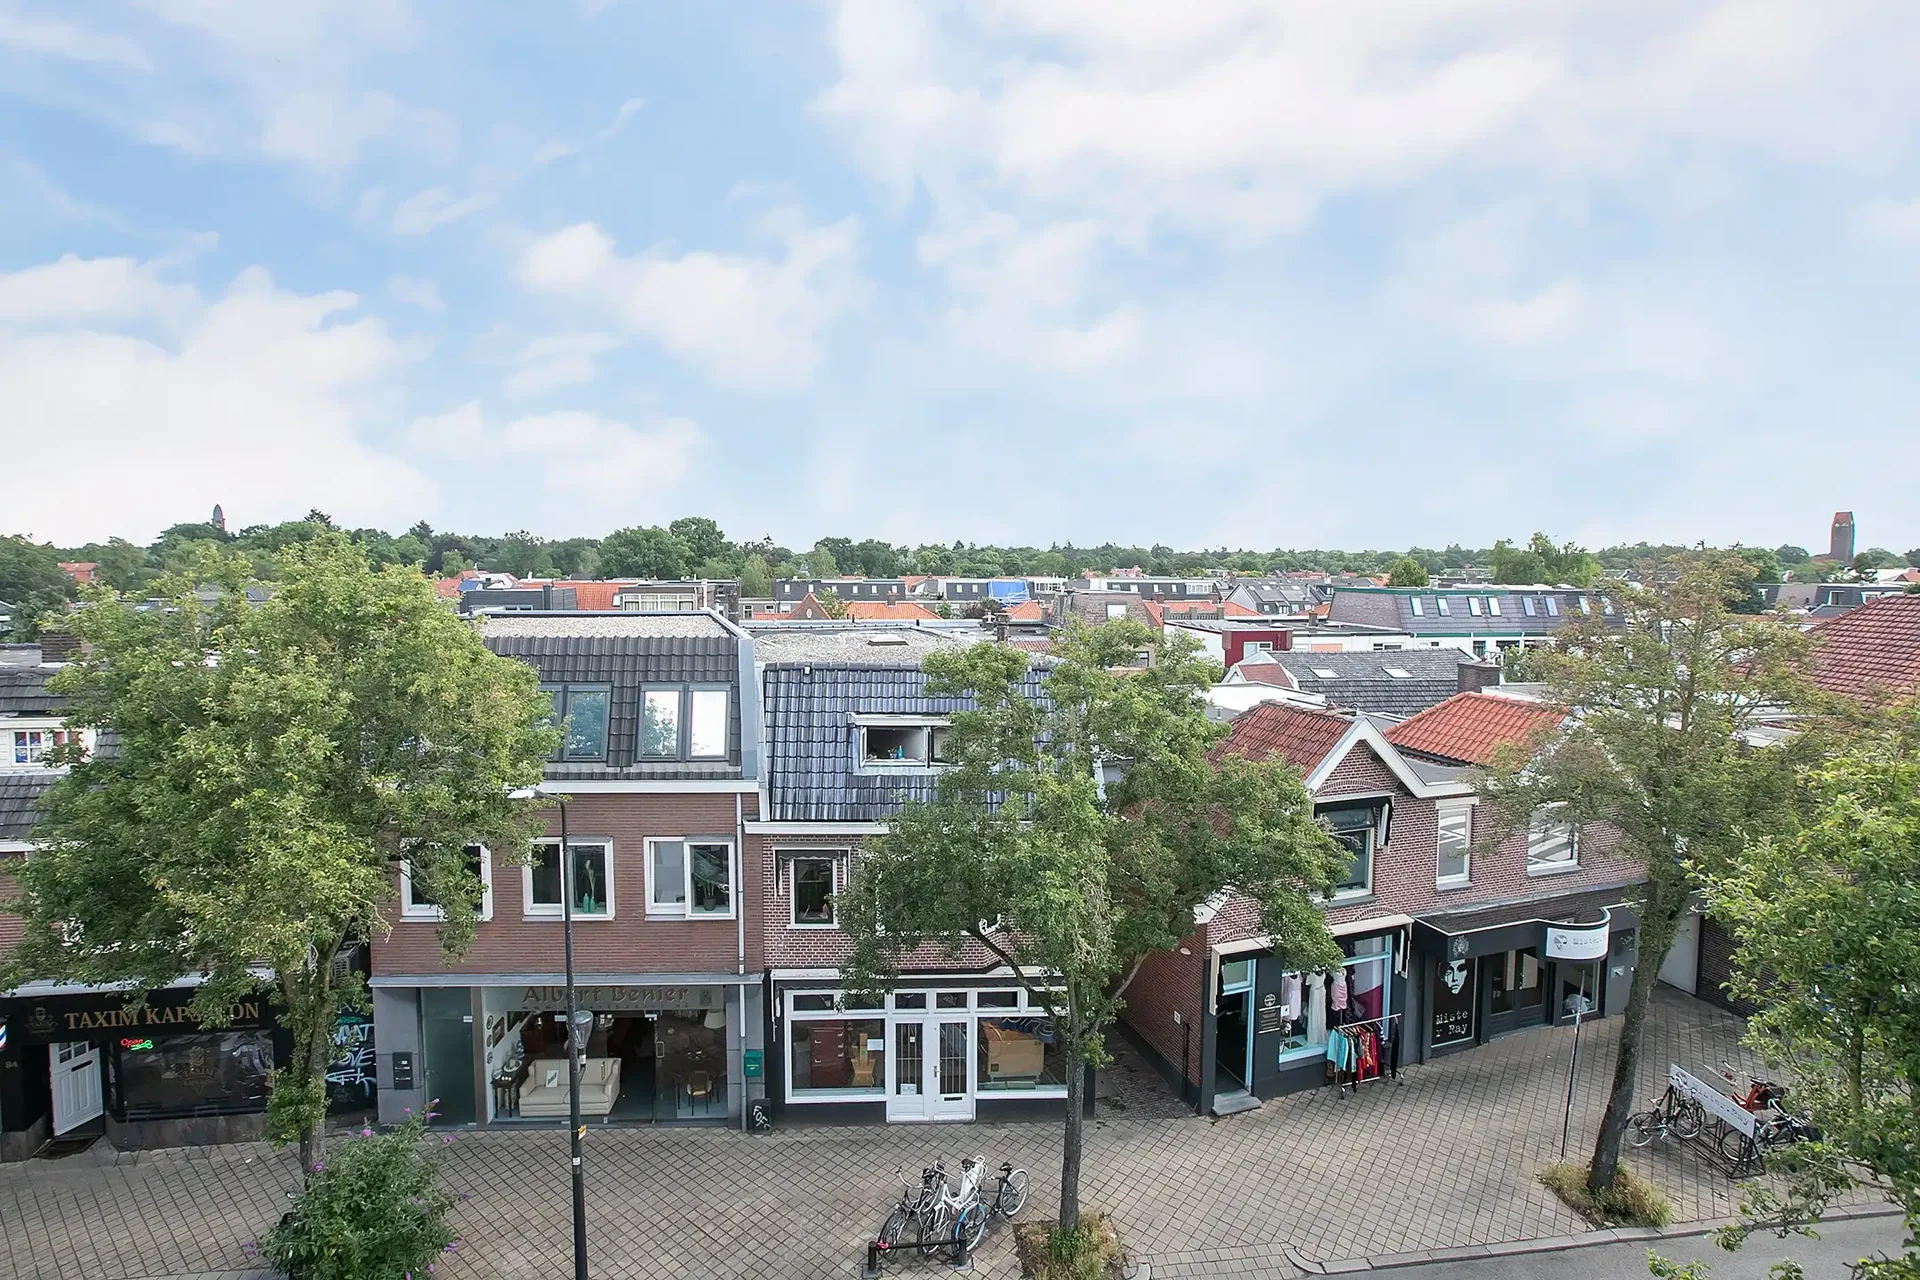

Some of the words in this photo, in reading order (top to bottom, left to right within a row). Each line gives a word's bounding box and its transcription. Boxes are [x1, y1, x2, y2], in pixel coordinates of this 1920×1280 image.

[522, 986, 601, 1003] Albrt
[65, 1009, 139, 1030] TAXIM
[1436, 1010, 1468, 1025] Miste
[1448, 1023, 1468, 1035] Ray
[120, 1038, 143, 1048] Open
